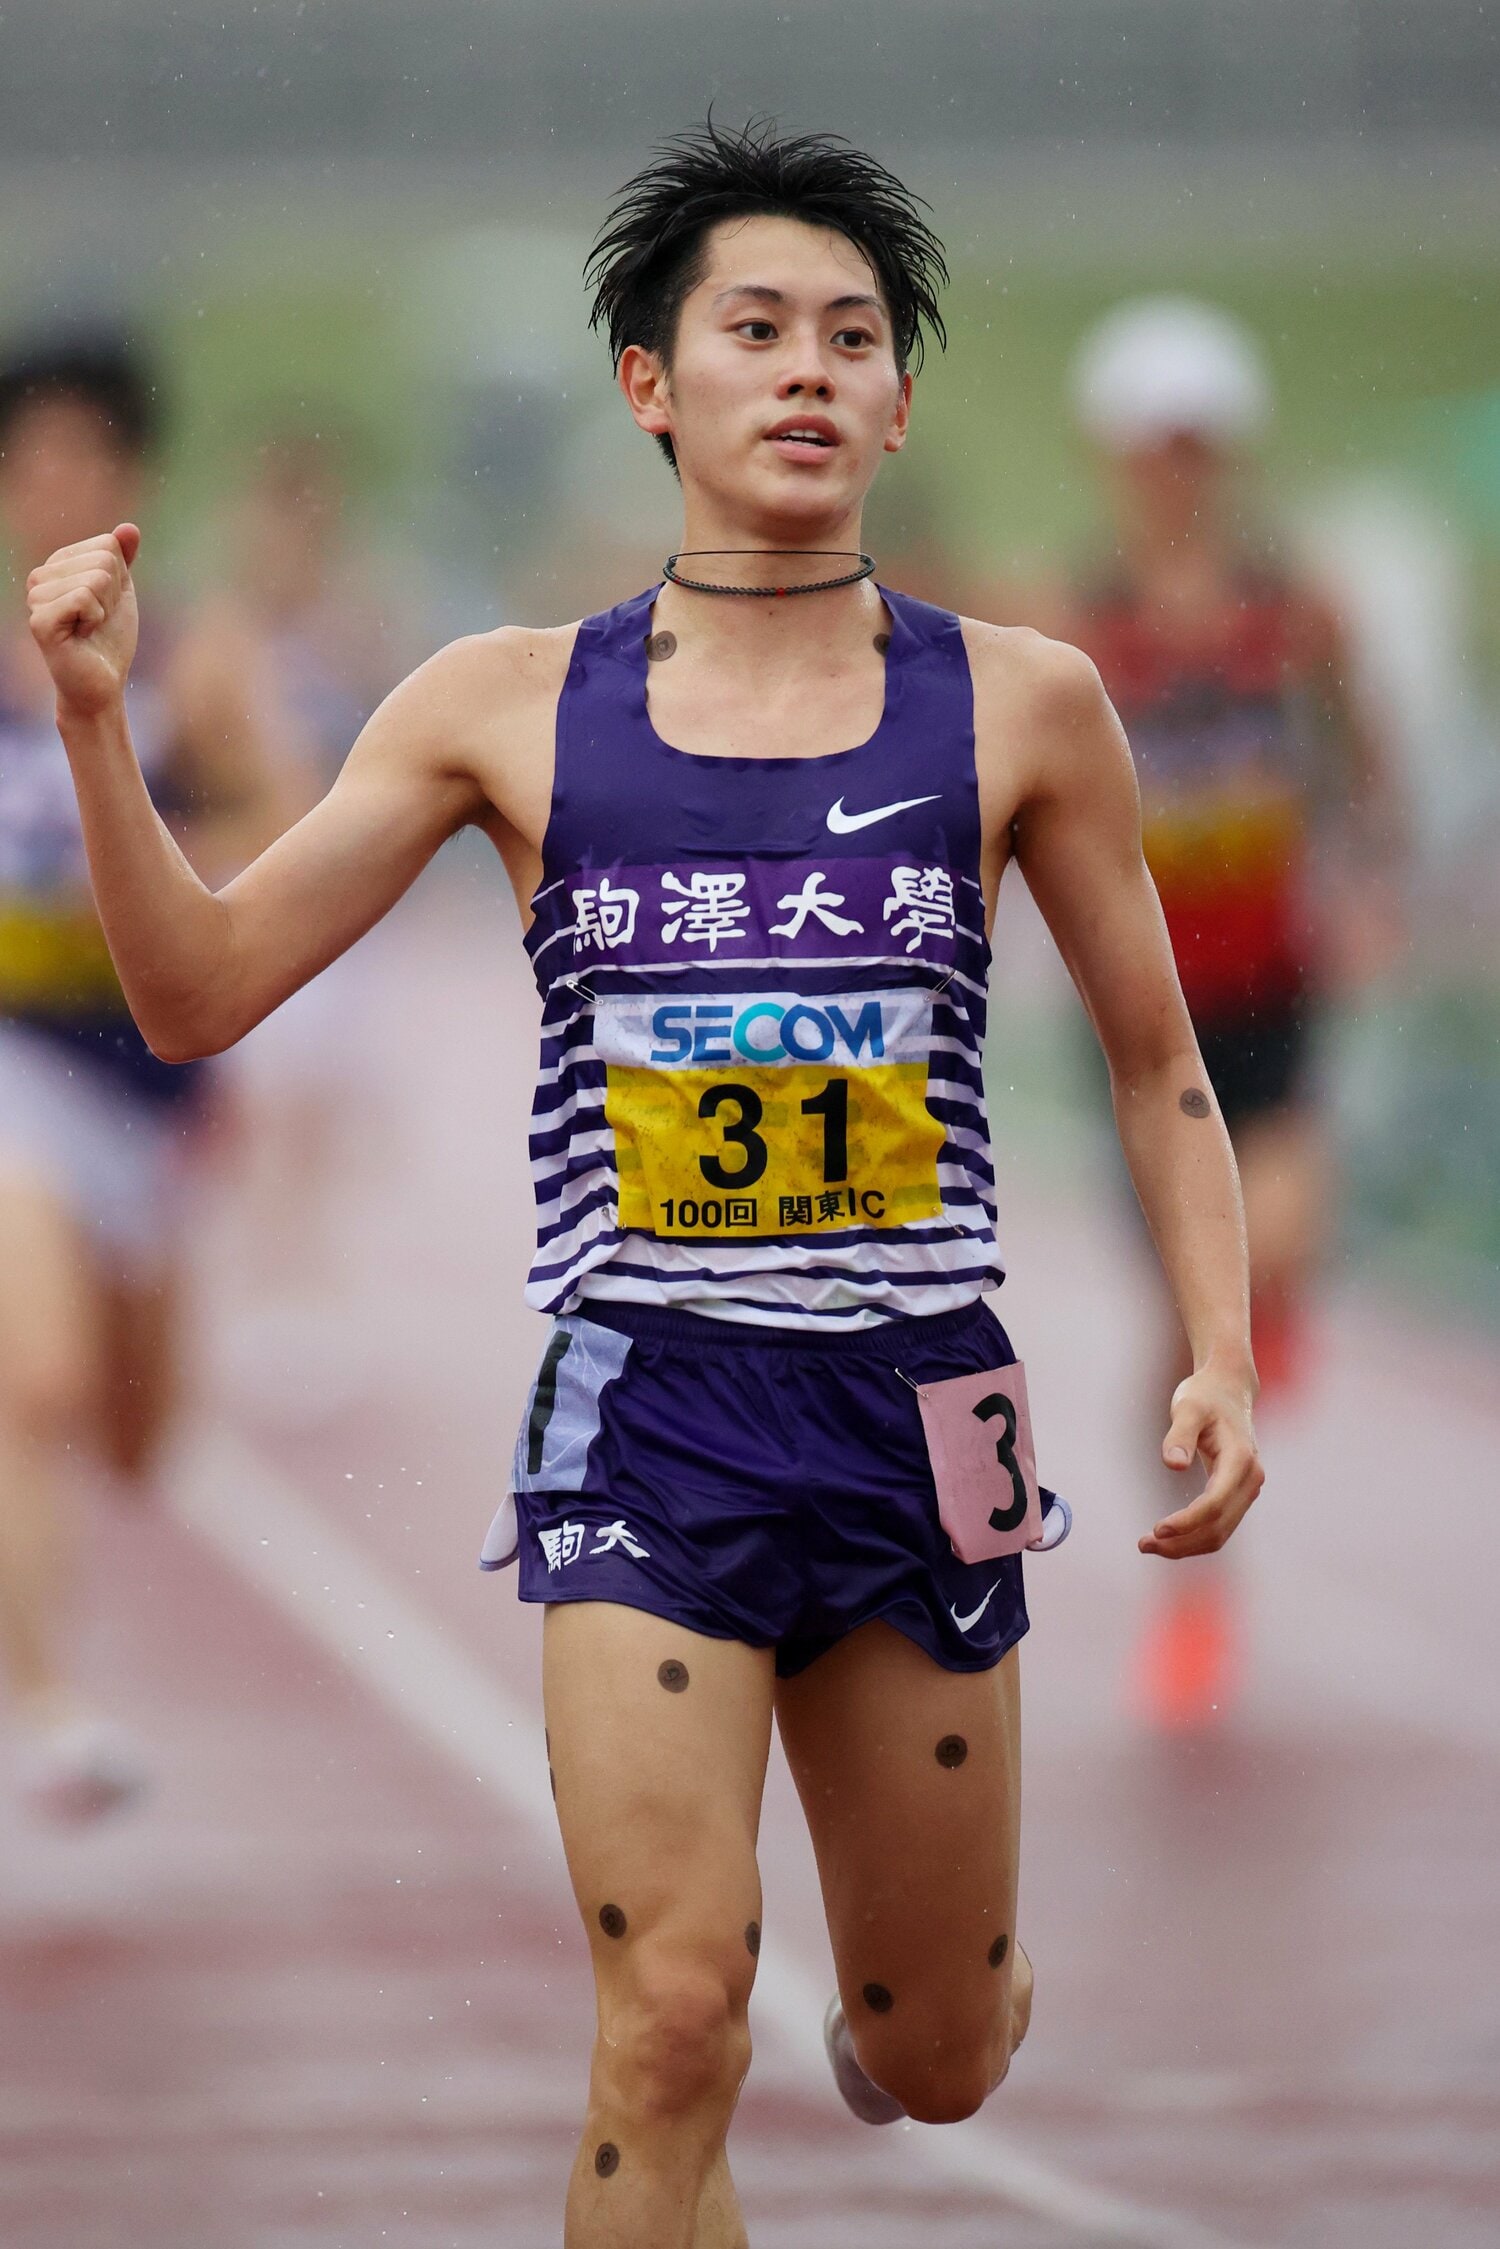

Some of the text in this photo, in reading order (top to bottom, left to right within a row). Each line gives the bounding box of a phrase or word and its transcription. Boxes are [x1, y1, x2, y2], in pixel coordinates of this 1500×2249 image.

[650, 1001, 886, 1063] SECOM
[698, 1078, 850, 1190] 31
[660, 1189, 886, 1228] 100回 関東IC
[971, 1392, 1028, 1532] 3
[538, 1520, 651, 1574] 駒大
